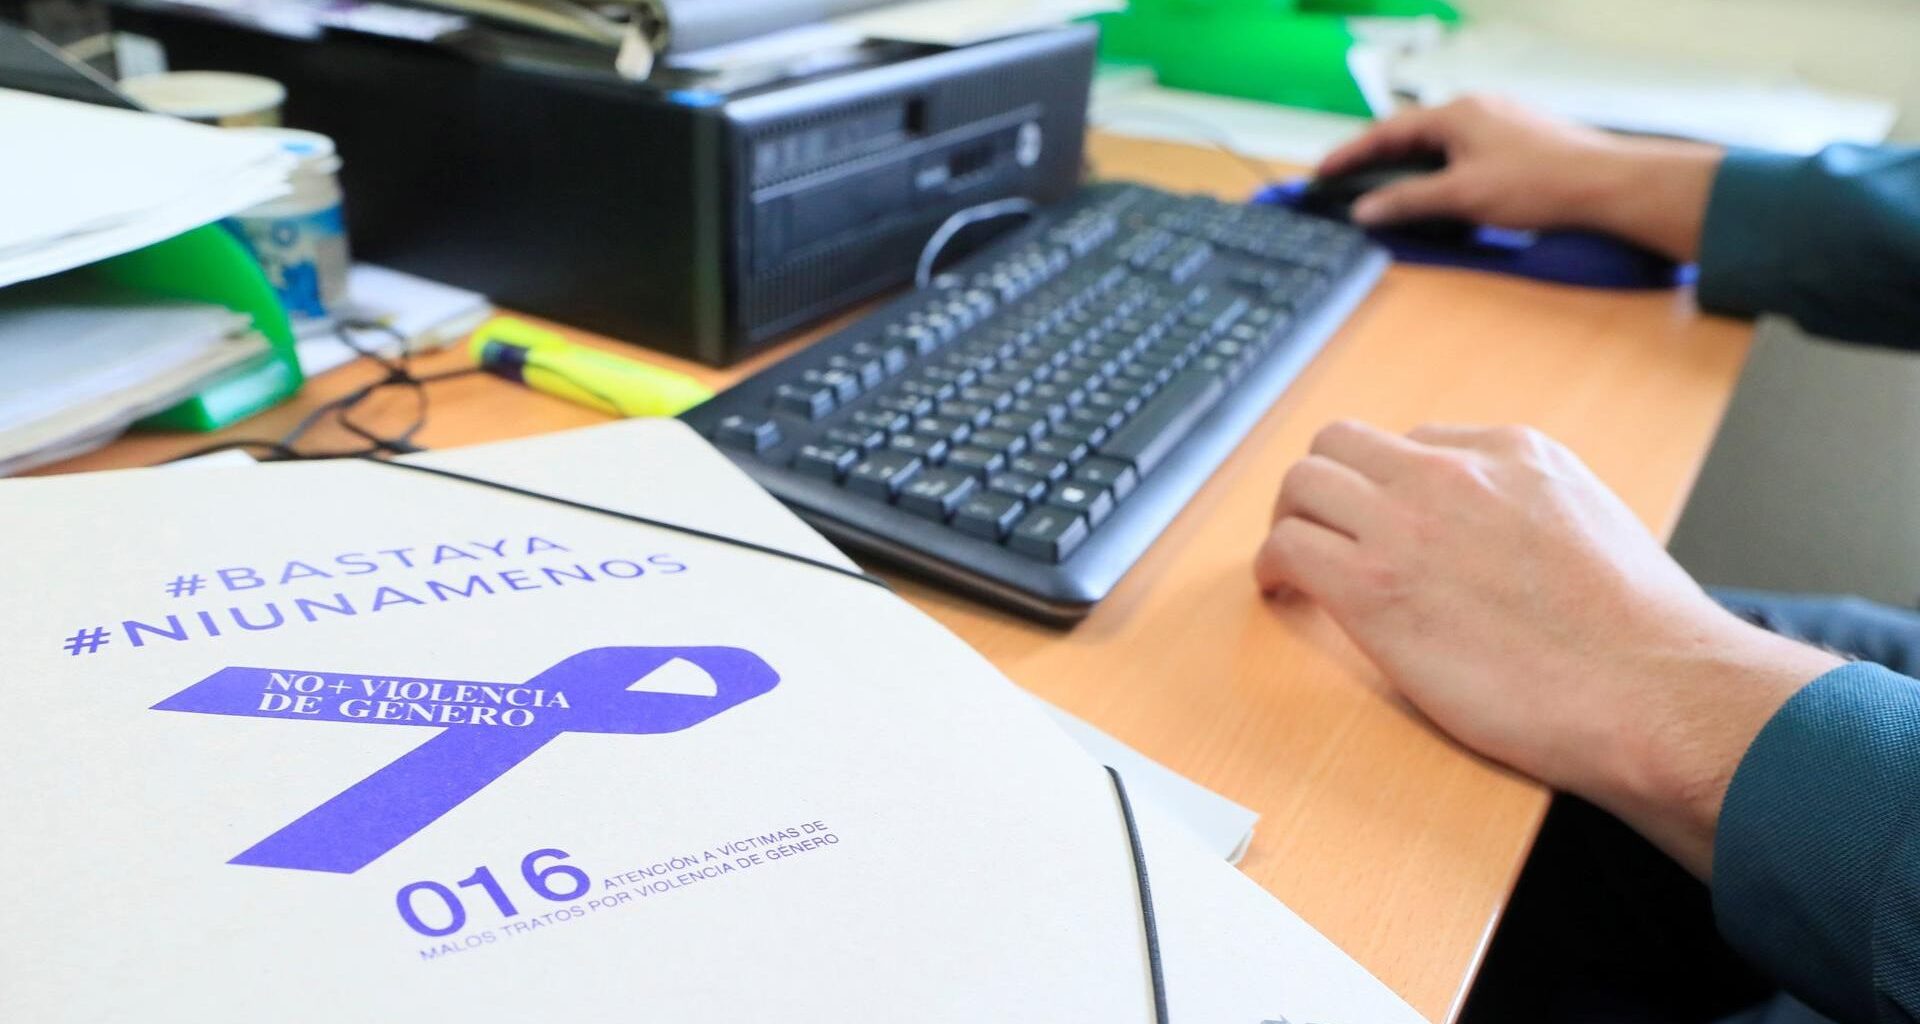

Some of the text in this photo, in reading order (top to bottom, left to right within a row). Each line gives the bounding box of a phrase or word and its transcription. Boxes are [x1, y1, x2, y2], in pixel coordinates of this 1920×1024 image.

[63, 553, 688, 656] #NIUNAMENOS
[165, 535, 572, 598] #BASTAYA
[257, 693, 323, 714] DE
[360, 679, 571, 709] VIOLENCIA
[396, 820, 828, 937] 016 ATENCIÓN A VÍCTIMAS DE
[420, 931, 497, 960] MALOS
[501, 905, 585, 937] TRATOS
[588, 890, 633, 912] POR
[634, 862, 737, 898] VIOLENCIA
[737, 853, 764, 869] DE
